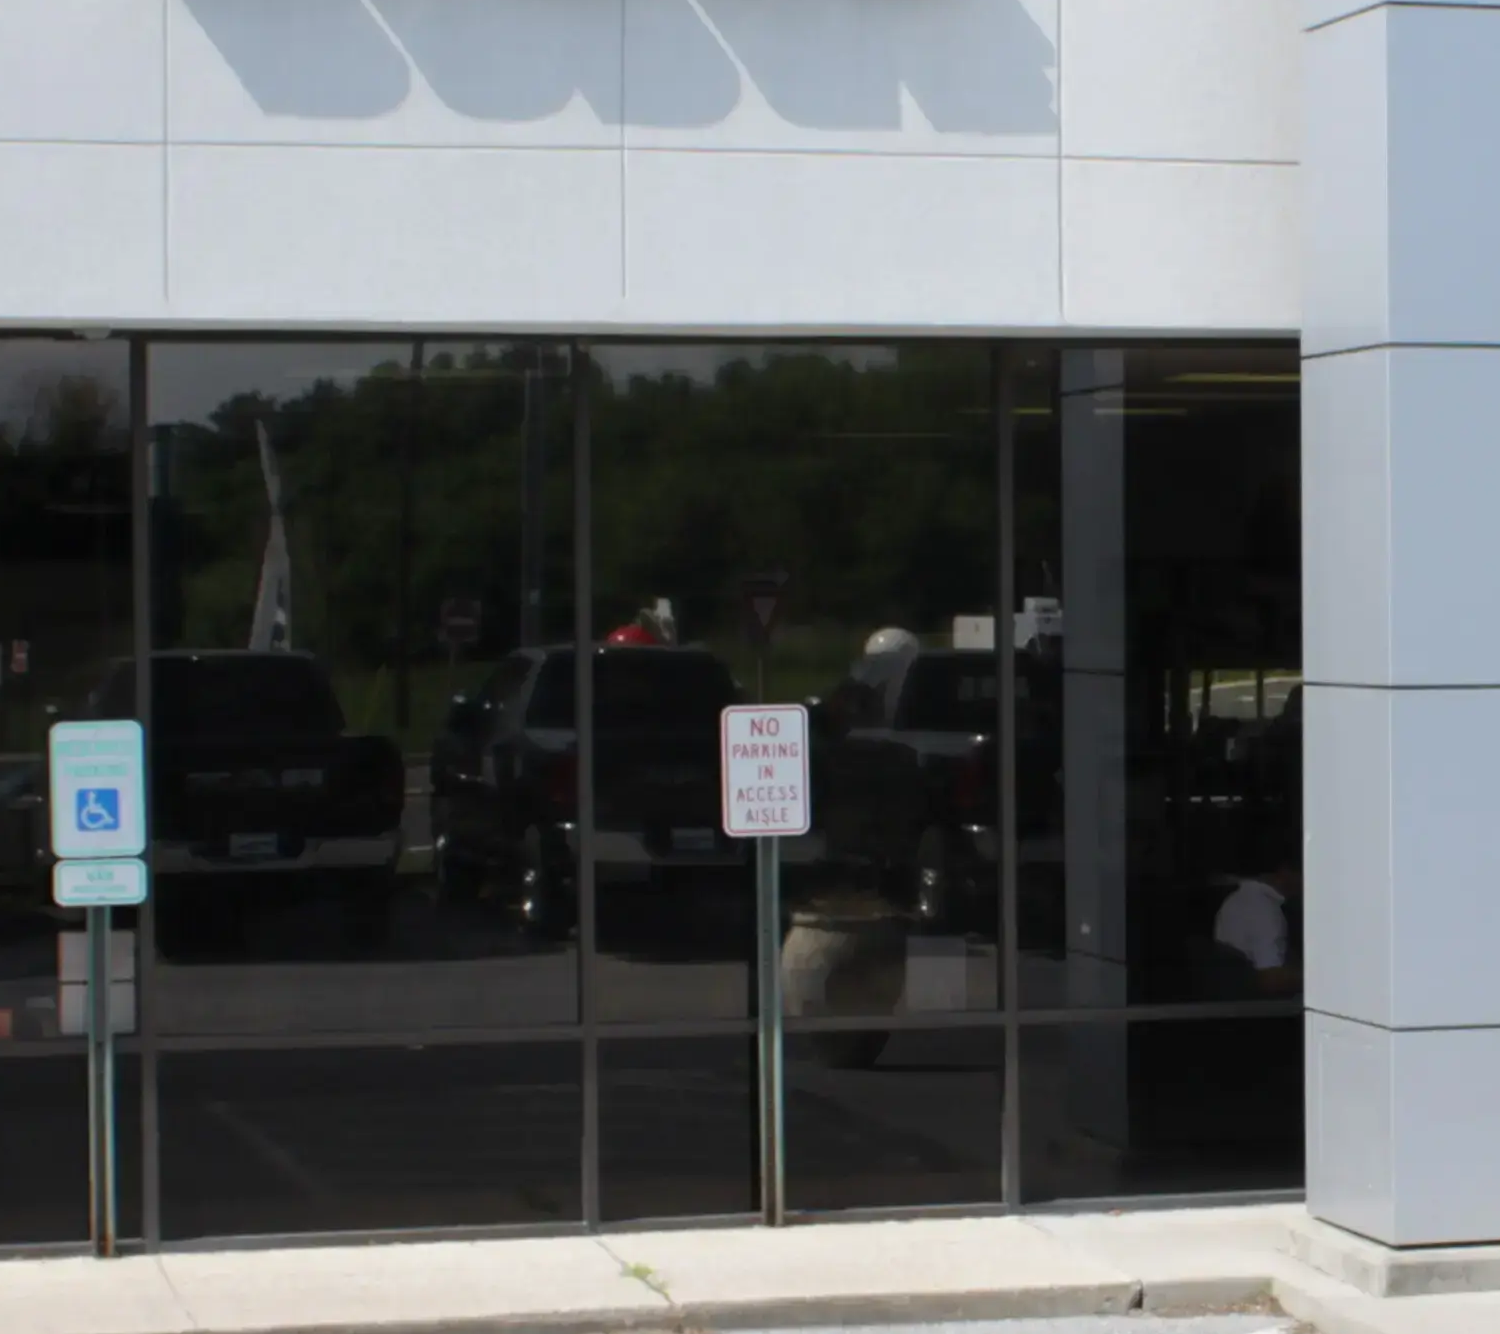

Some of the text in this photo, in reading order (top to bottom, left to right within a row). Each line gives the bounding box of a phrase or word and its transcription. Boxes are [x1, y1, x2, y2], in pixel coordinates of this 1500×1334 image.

[750, 717, 780, 737] NO
[731, 742, 799, 760] PARKING
[757, 764, 775, 781] IN
[736, 785, 798, 803] ACCESS
[746, 807, 790, 825] AISLE
